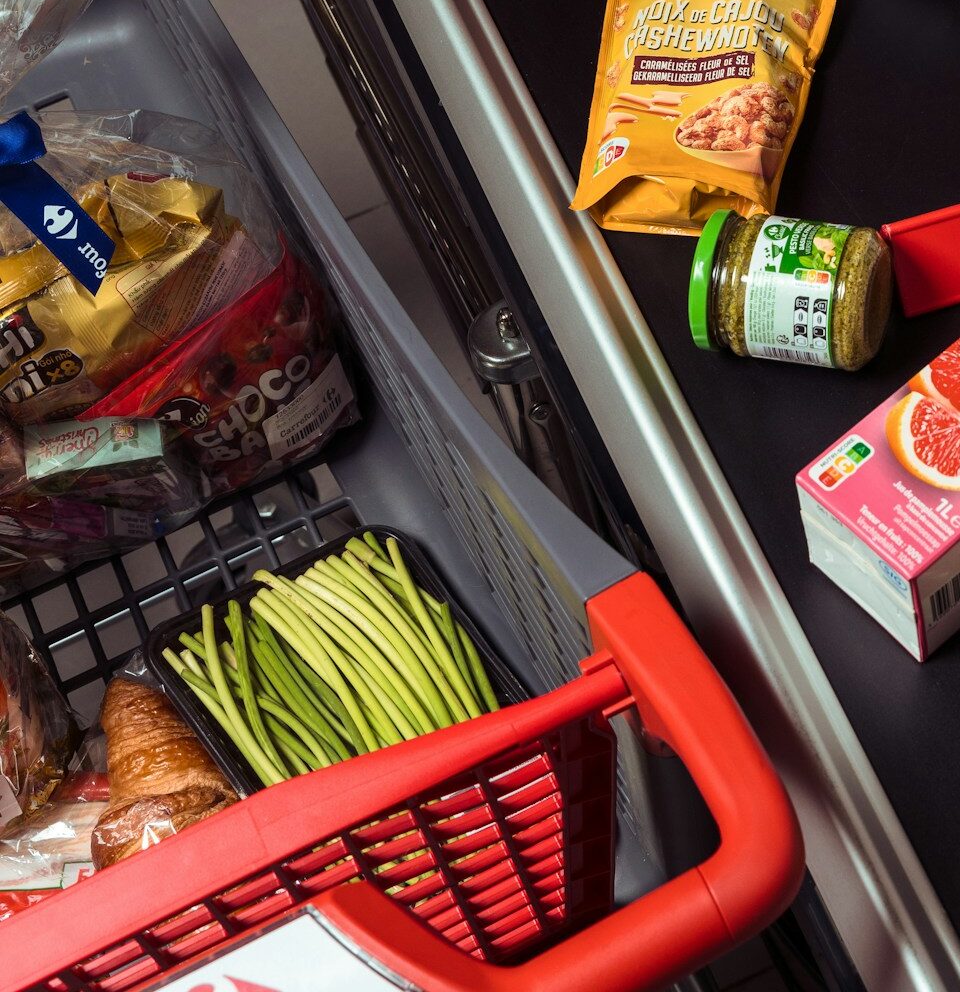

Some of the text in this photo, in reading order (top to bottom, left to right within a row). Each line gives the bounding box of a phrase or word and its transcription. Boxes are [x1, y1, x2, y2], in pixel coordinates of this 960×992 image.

[690, 9, 707, 23] DE
[709, 0, 786, 33] CAJOU
[623, 22, 790, 63] CASHEWNOTEN
[632, 67, 752, 83] GEKARAMELLISEERD FLEUR DE SEL
[640, 55, 750, 71] CARAMÉLISÉES FLEUR DE SEL
[789, 234, 800, 254] PESTO
[193, 355, 311, 448] CHOCO
[819, 438, 856, 469] NUTRI-SCORE
[935, 498, 953, 520] 1L
[860, 504, 924, 564] Teneur en fruits 100%
